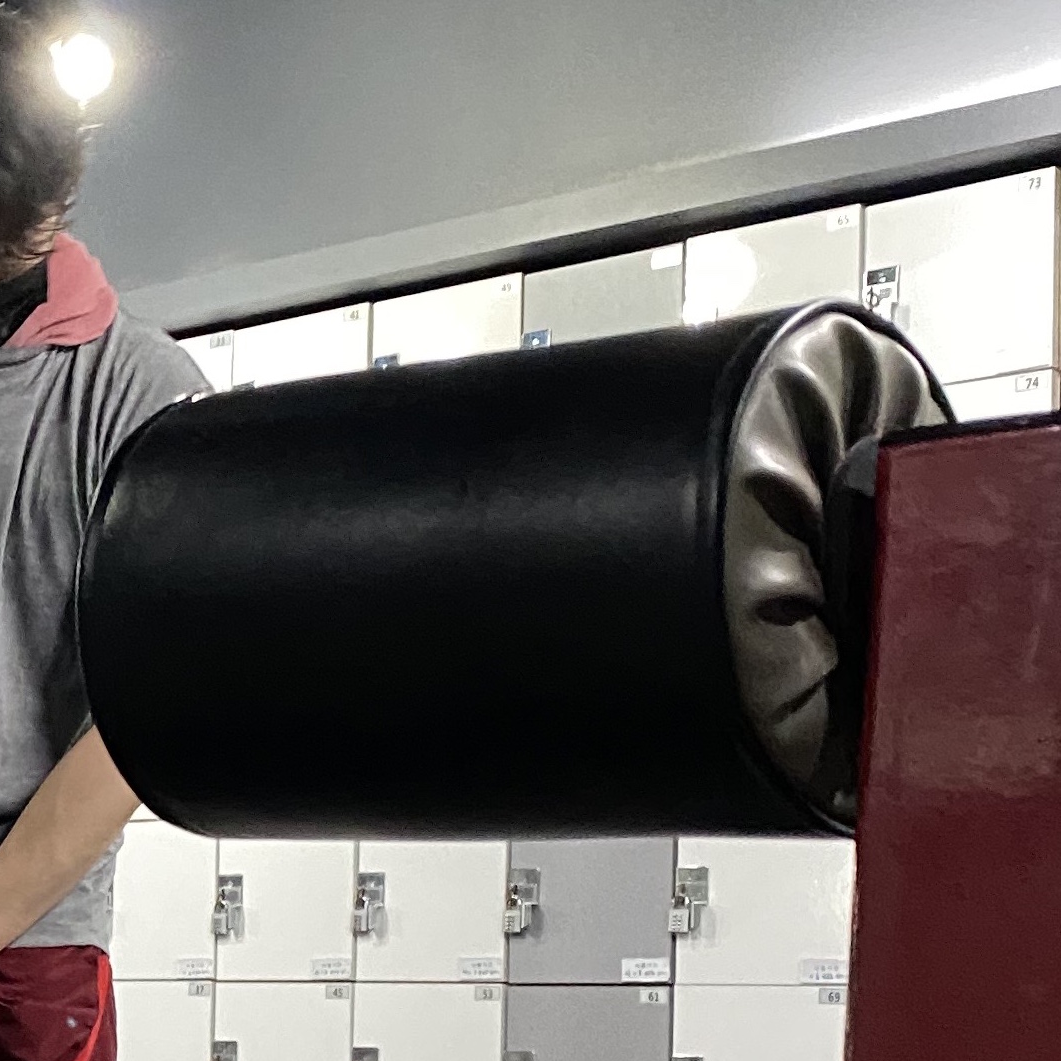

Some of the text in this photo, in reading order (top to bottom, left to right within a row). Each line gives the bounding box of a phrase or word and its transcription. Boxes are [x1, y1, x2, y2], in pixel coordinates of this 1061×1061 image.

[1029, 177, 1041, 189] 73
[1026, 376, 1039, 389] 74
[648, 992, 659, 1002] 61
[828, 992, 841, 1003] 69
